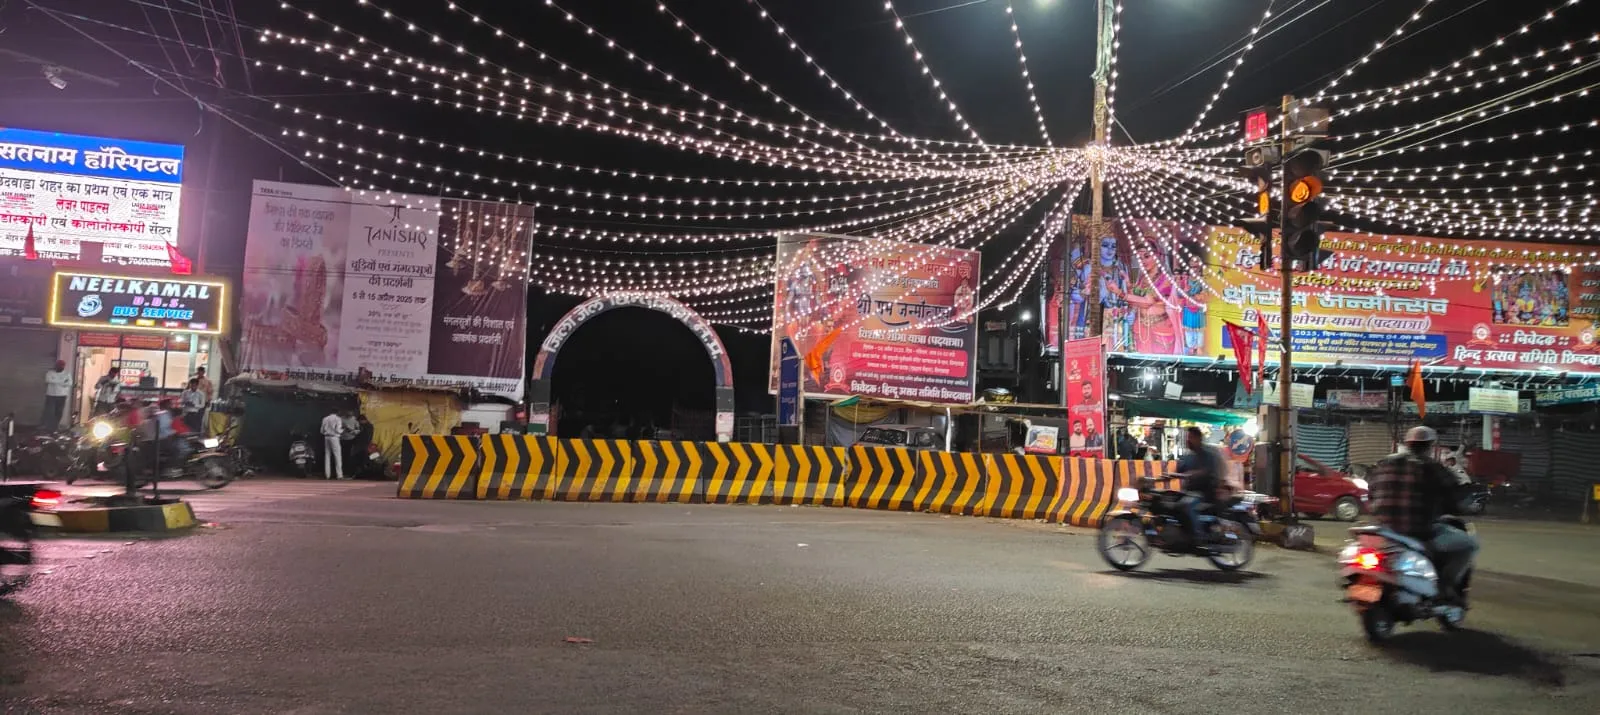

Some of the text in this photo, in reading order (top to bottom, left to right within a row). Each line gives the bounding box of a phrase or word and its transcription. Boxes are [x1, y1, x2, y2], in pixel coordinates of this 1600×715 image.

[0, 143, 181, 175] सतनाम हॉस्पिटल
[40, 180, 63, 192] शहर
[66, 182, 80, 193] का
[85, 184, 109, 196] प्रथम
[132, 189, 148, 200] एक
[364, 225, 427, 250] TANISHQ
[69, 276, 210, 299] NEELKAMAL
[112, 305, 194, 320] BUS SERVICE
[1512, 329, 1557, 346] निवेदक
[1453, 345, 1482, 365] हिन्दू
